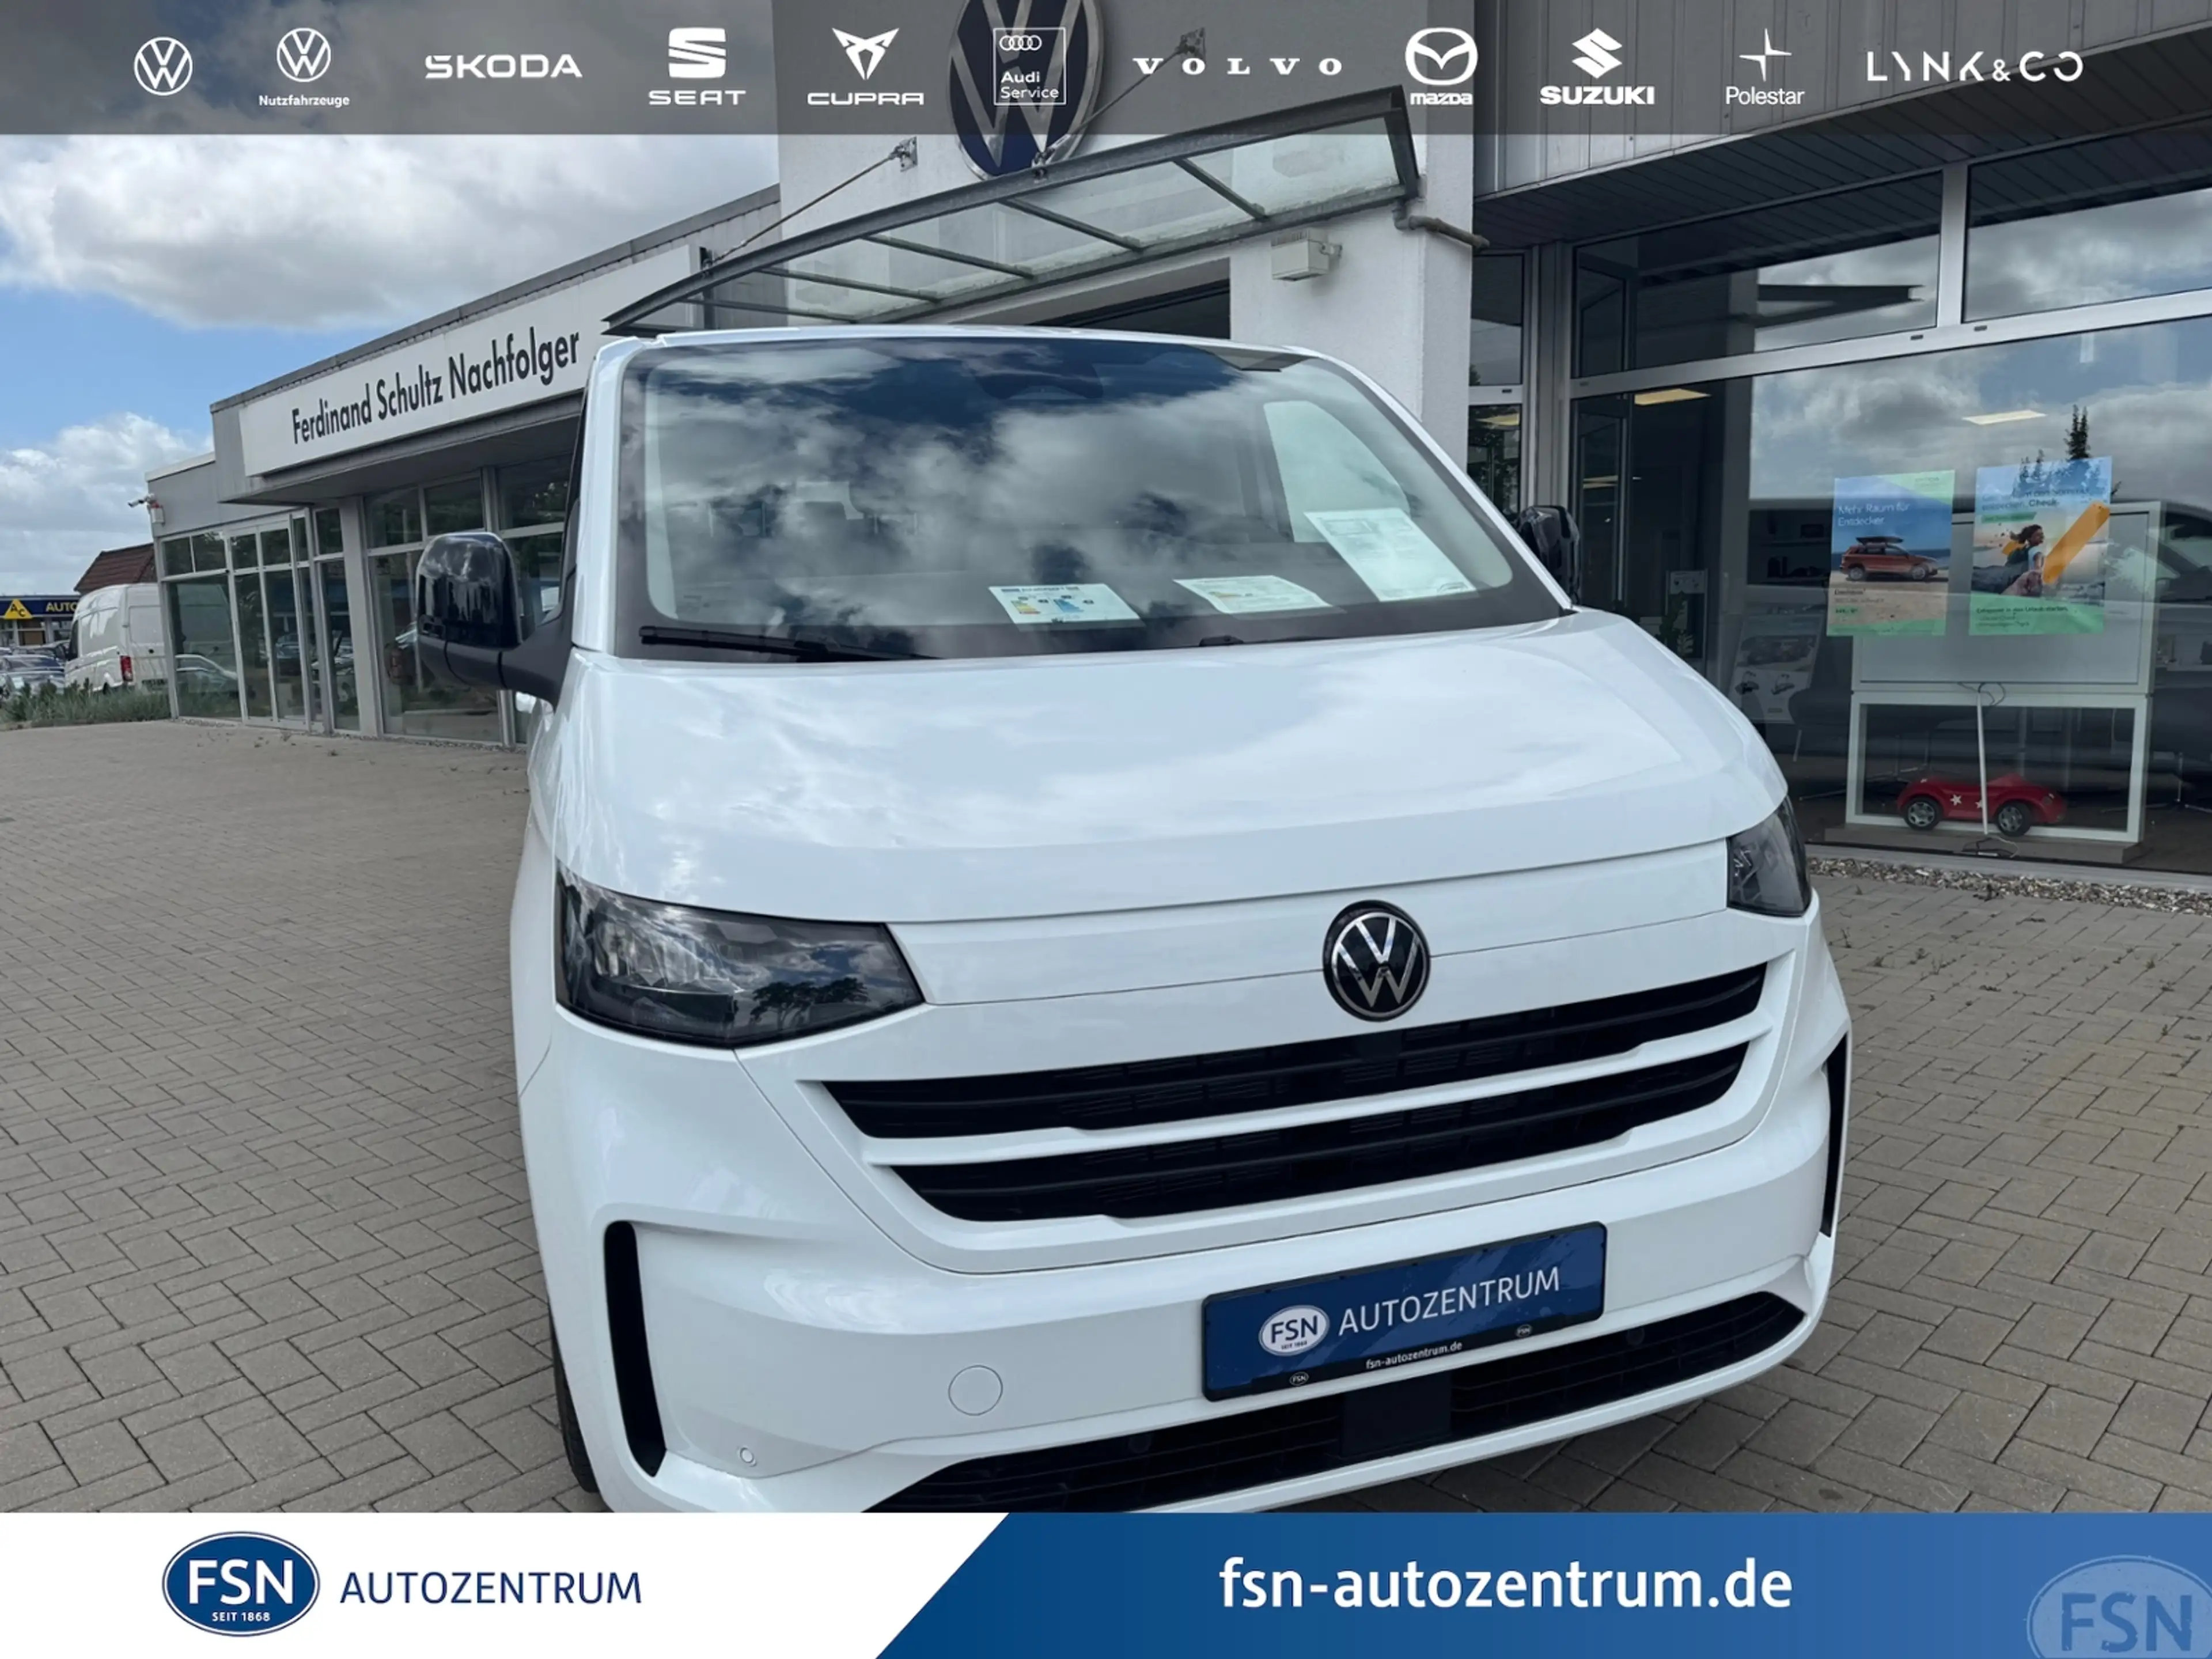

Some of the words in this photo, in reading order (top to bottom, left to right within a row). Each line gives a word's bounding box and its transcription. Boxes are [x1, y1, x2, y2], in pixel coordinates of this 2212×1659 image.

[292, 382, 372, 445] Ferdinand
[376, 364, 444, 421] Schultz
[448, 325, 580, 399] Nachfolger
[1866, 503, 1895, 513] Raum
[1271, 1315, 1318, 1344] FSN
[1338, 1266, 1560, 1336] AUTOZENTRUM
[1365, 1340, 1463, 1369] fsn-autozentrum.de
